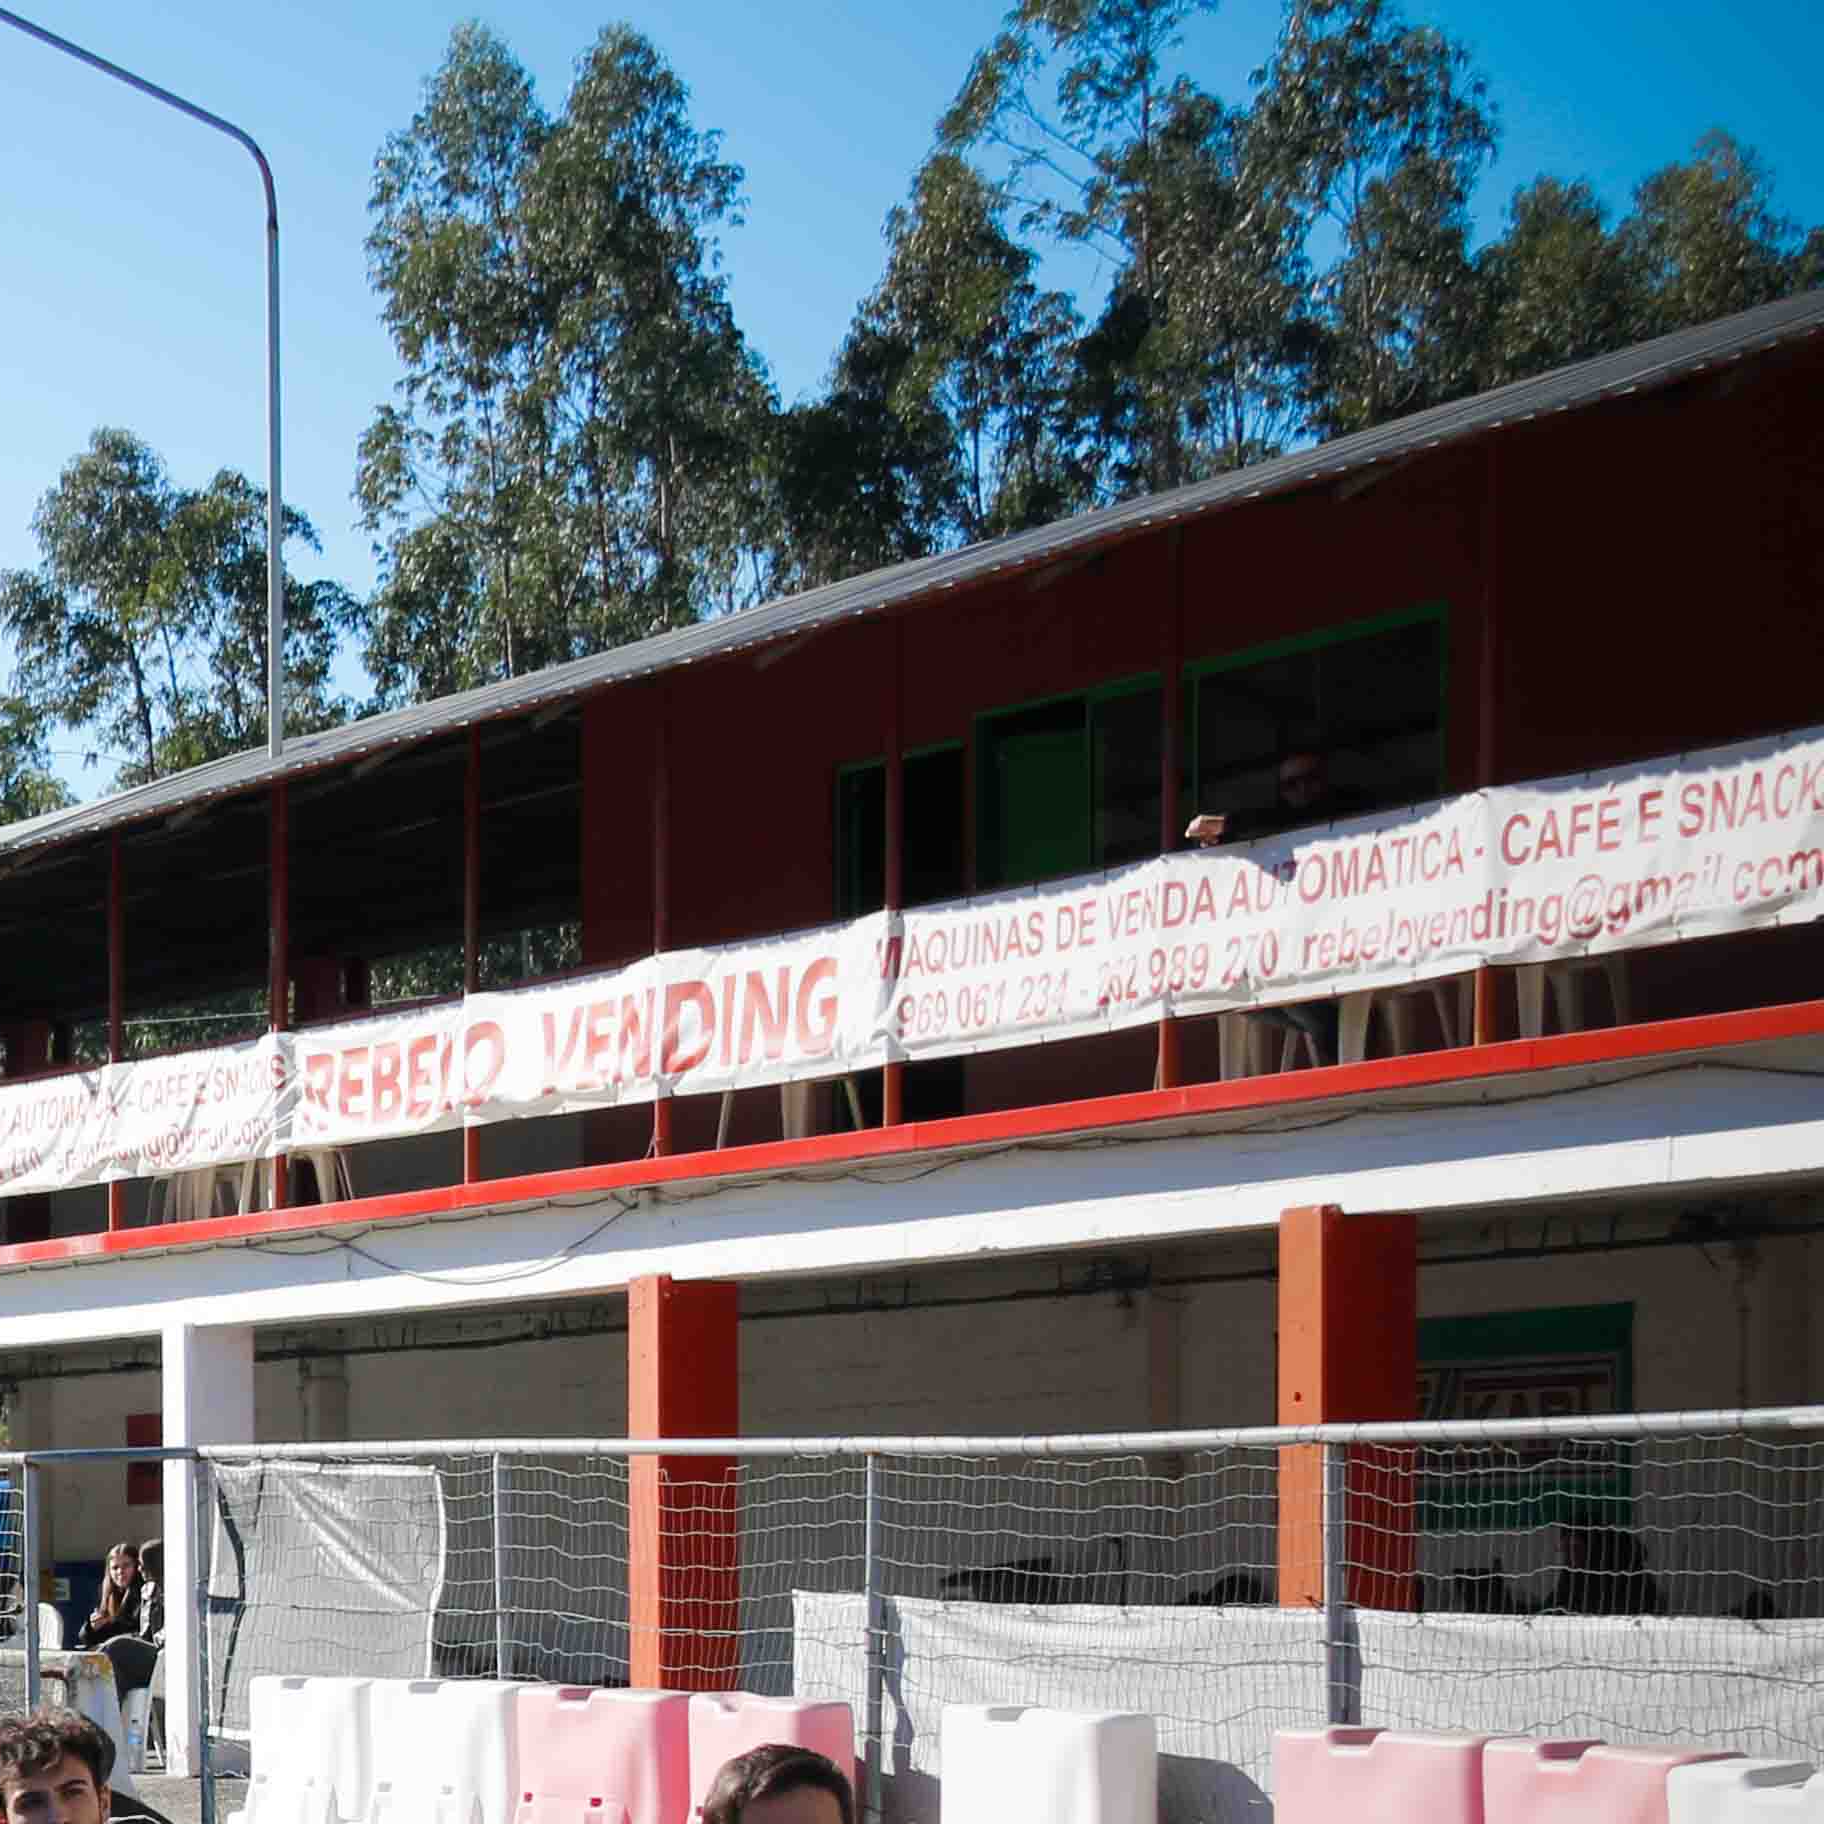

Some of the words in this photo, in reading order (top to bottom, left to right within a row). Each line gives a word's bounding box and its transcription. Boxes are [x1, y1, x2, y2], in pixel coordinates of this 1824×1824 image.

[1056, 900, 1097, 952] DE
[1106, 876, 1216, 939] VENDA
[1500, 783, 1623, 866] CAFÉ
[1637, 790, 1663, 843] E
[304, 1018, 505, 1132] REBELO
[541, 956, 840, 1094] VENDING
